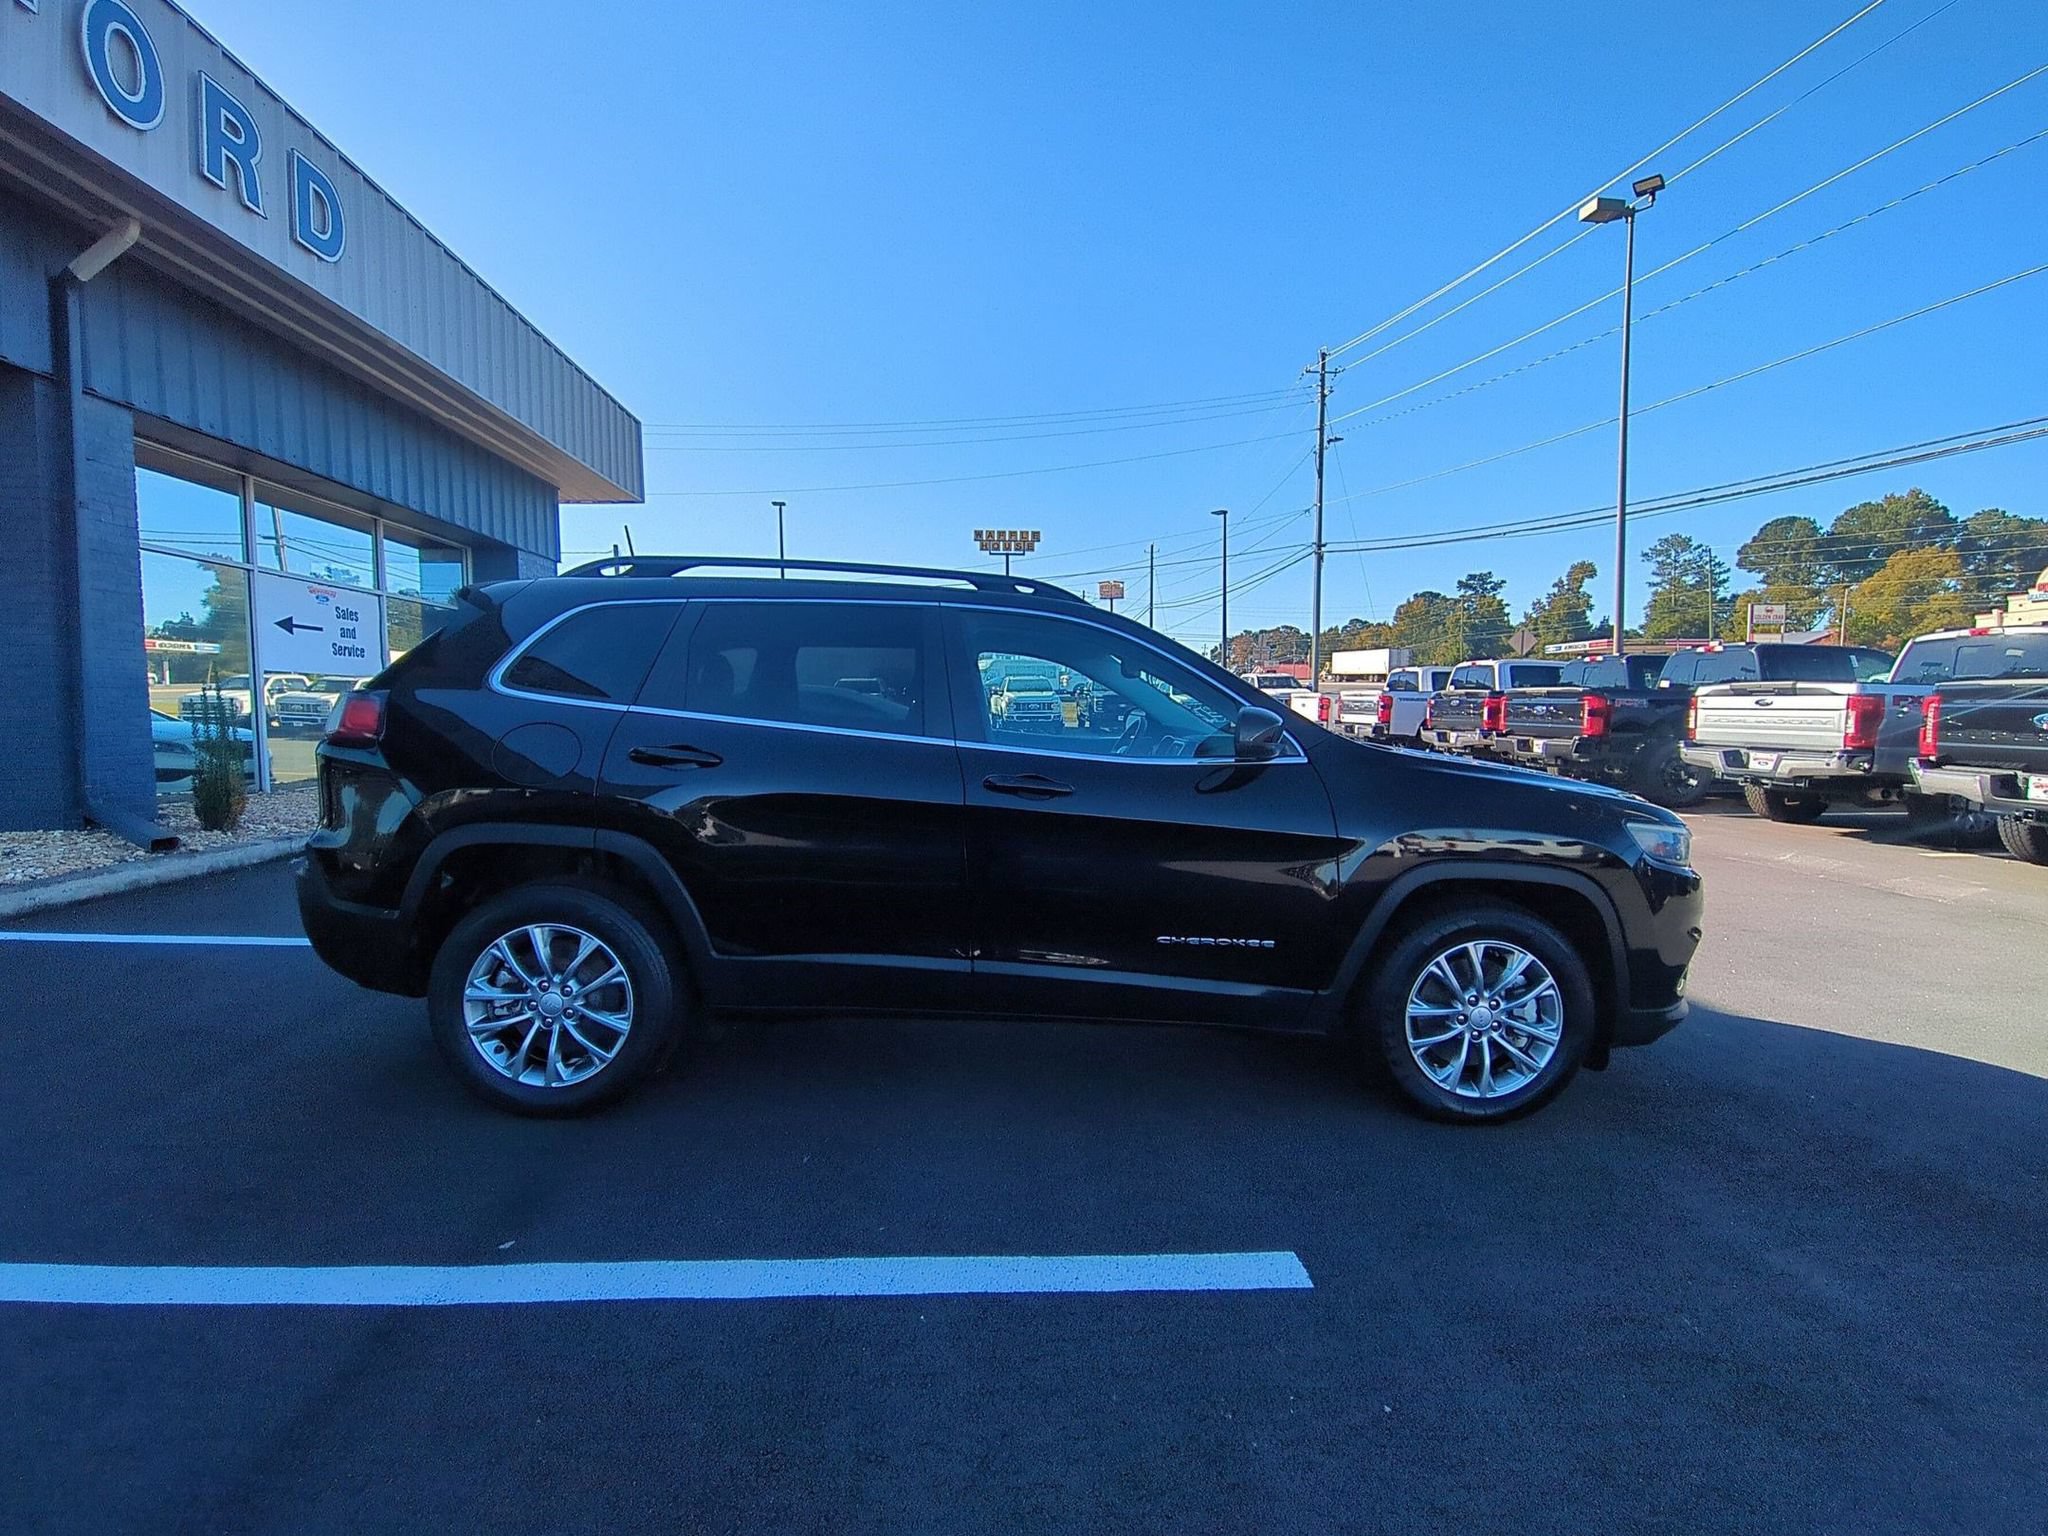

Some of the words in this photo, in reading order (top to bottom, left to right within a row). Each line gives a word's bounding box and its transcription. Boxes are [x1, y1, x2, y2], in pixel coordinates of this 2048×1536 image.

[14, 0, 346, 263] ORD
[974, 530, 1040, 541] WAFFLE
[979, 541, 1034, 551] HOUSE
[335, 606, 359, 622] Sales
[340, 627, 357, 640] and
[331, 643, 365, 658] Service
[1156, 936, 1275, 947] CHEROKEE
